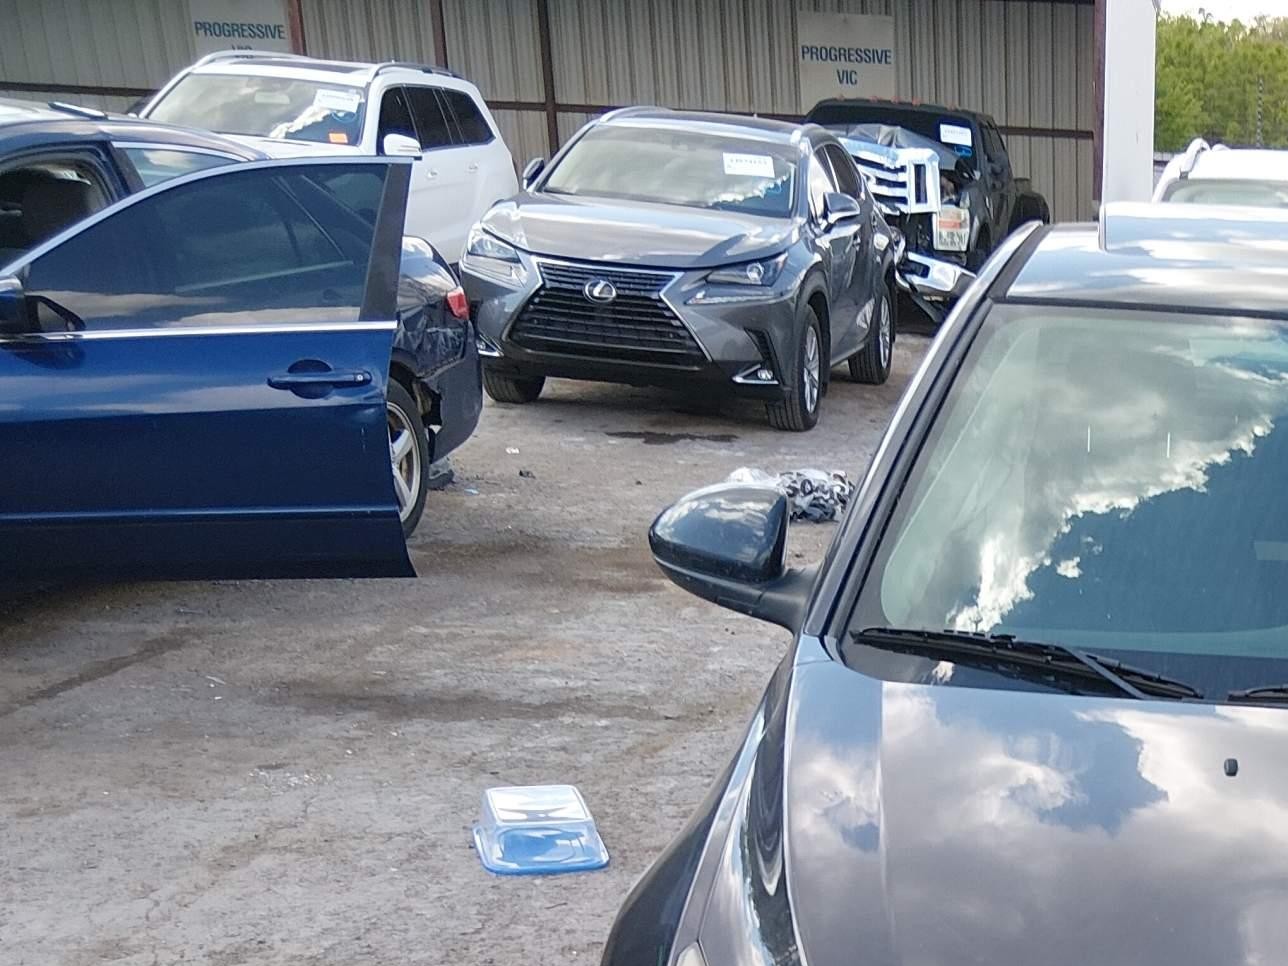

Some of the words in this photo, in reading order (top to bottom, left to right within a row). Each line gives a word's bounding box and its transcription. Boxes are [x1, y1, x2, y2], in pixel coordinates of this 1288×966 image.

[194, 21, 286, 40] PROGRESSIVE
[800, 45, 892, 64] PROGRESSIVE
[836, 69, 858, 86] VIC
